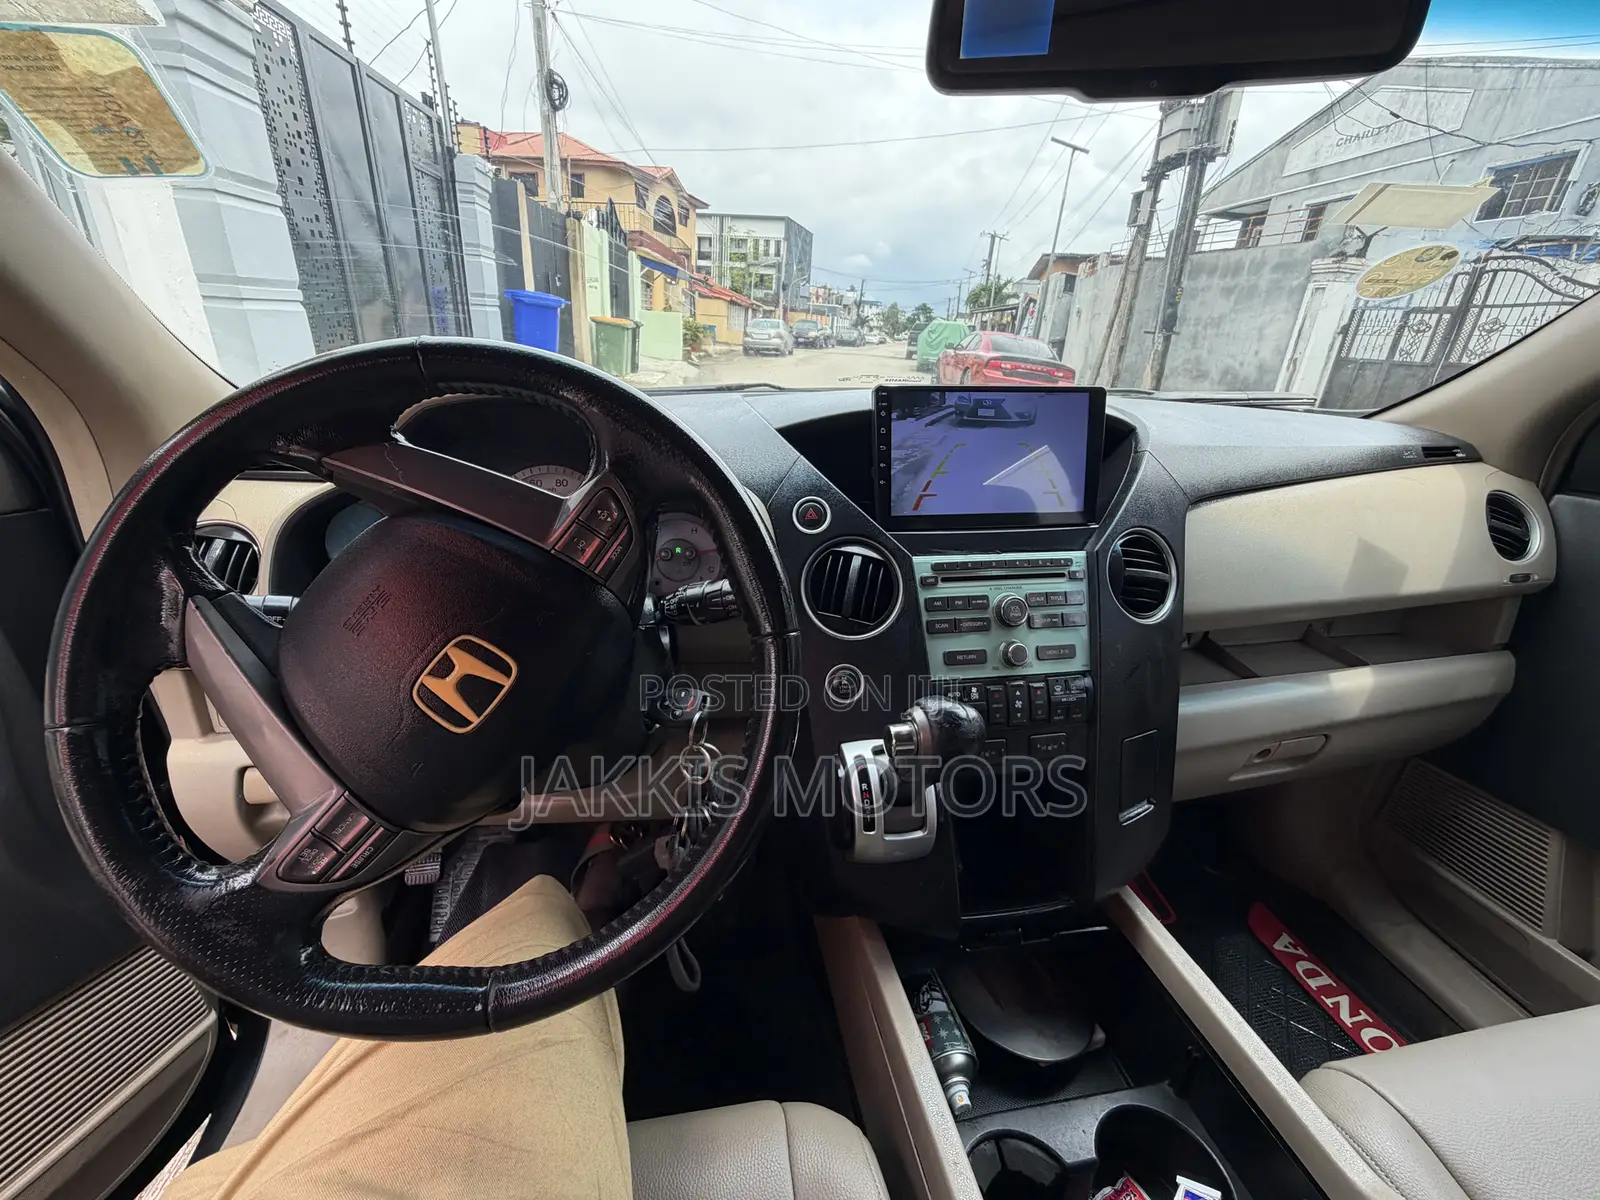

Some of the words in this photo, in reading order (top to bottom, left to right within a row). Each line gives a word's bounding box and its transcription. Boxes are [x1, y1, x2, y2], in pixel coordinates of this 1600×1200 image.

[555, 479, 569, 488] 80
[861, 783, 869, 791] R
[332, 813, 357, 835] CANCEL
[351, 846, 374, 869] CRUISE
[1272, 932, 1401, 1054] ONDA
